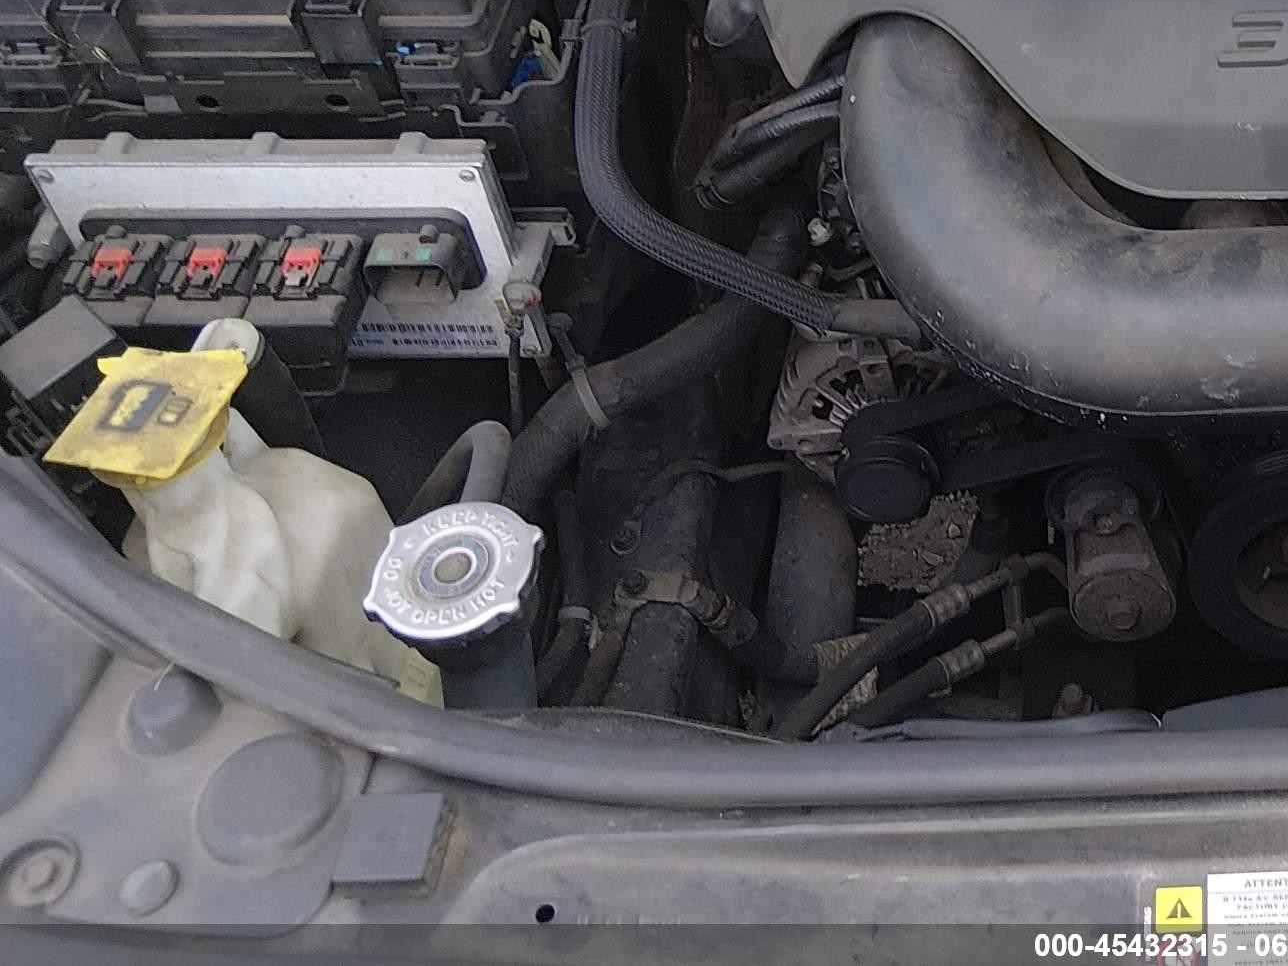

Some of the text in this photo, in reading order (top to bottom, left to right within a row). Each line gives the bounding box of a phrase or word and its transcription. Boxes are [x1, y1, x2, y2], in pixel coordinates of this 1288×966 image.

[422, 509, 477, 536] KEEP
[384, 557, 402, 580] DO
[412, 606, 466, 625] OPEN
[470, 577, 505, 611] HOT
